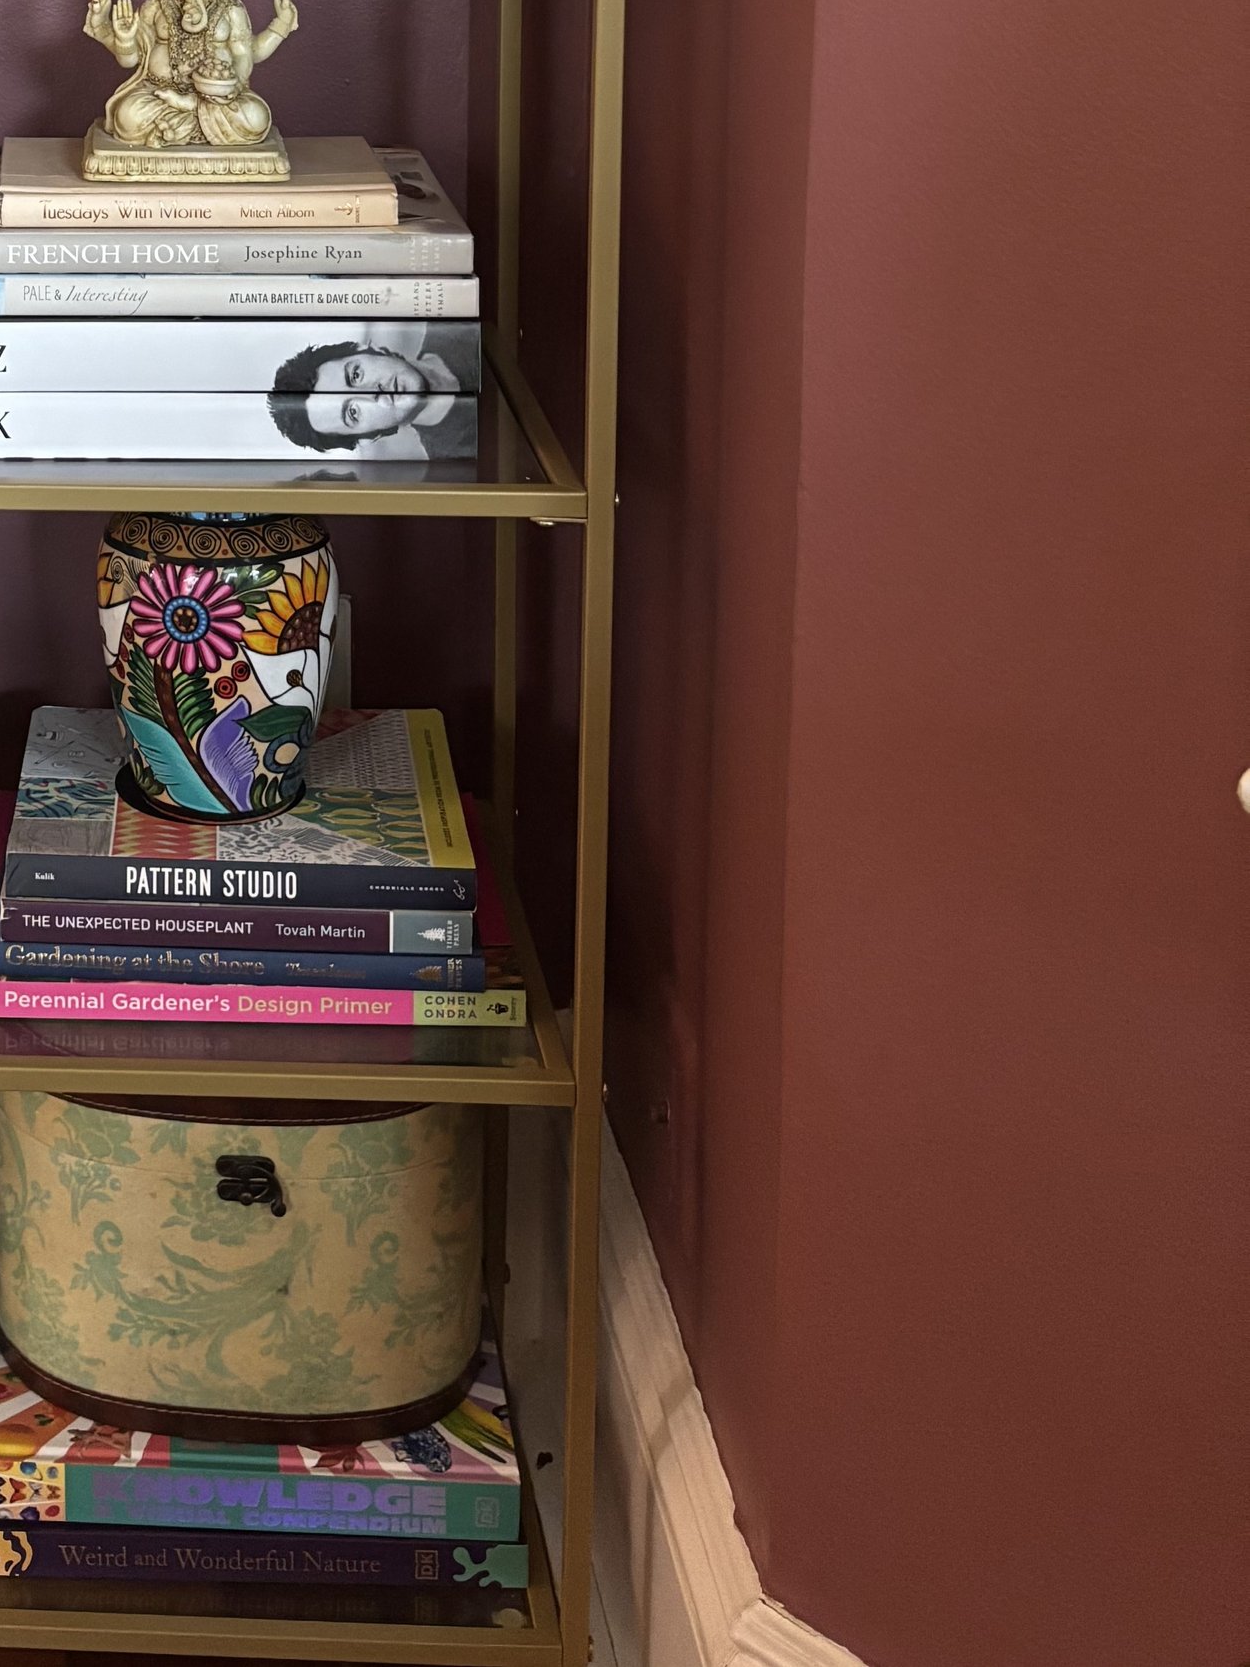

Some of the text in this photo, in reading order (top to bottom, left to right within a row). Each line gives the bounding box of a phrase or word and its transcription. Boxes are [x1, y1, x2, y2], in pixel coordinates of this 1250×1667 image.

[38, 199, 109, 223] Tuesdays
[114, 199, 153, 220] With
[240, 206, 272, 219] Mitch
[276, 204, 315, 219] Albom
[6, 243, 363, 265] FRENCH HOME Josephine Ryan
[23, 285, 149, 316] PALE & Interesting
[229, 292, 381, 305] ATLANTA BARTLETT & DAVE COOTE
[34, 865, 298, 900] Kulik PATTERN STUDIO
[22, 914, 366, 939] THE UNEXPECTED HOUSEPLANT Tovah Martin
[4, 944, 127, 975] Gardening
[131, 954, 153, 971] at
[157, 950, 194, 973] the
[198, 952, 266, 976] Shore
[3, 990, 105, 1009] Perennial
[111, 992, 231, 1013] Gardener's
[237, 994, 312, 1016] Design
[320, 997, 393, 1015] Primer
[424, 995, 477, 1006] COHEN
[424, 1008, 478, 1019] ONDRA
[93, 1470, 447, 1516] KNOWLEDGE
[243, 1511, 447, 1535] COMPENDIUM
[58, 1544, 382, 1574] Weird and Wonderful Nature
